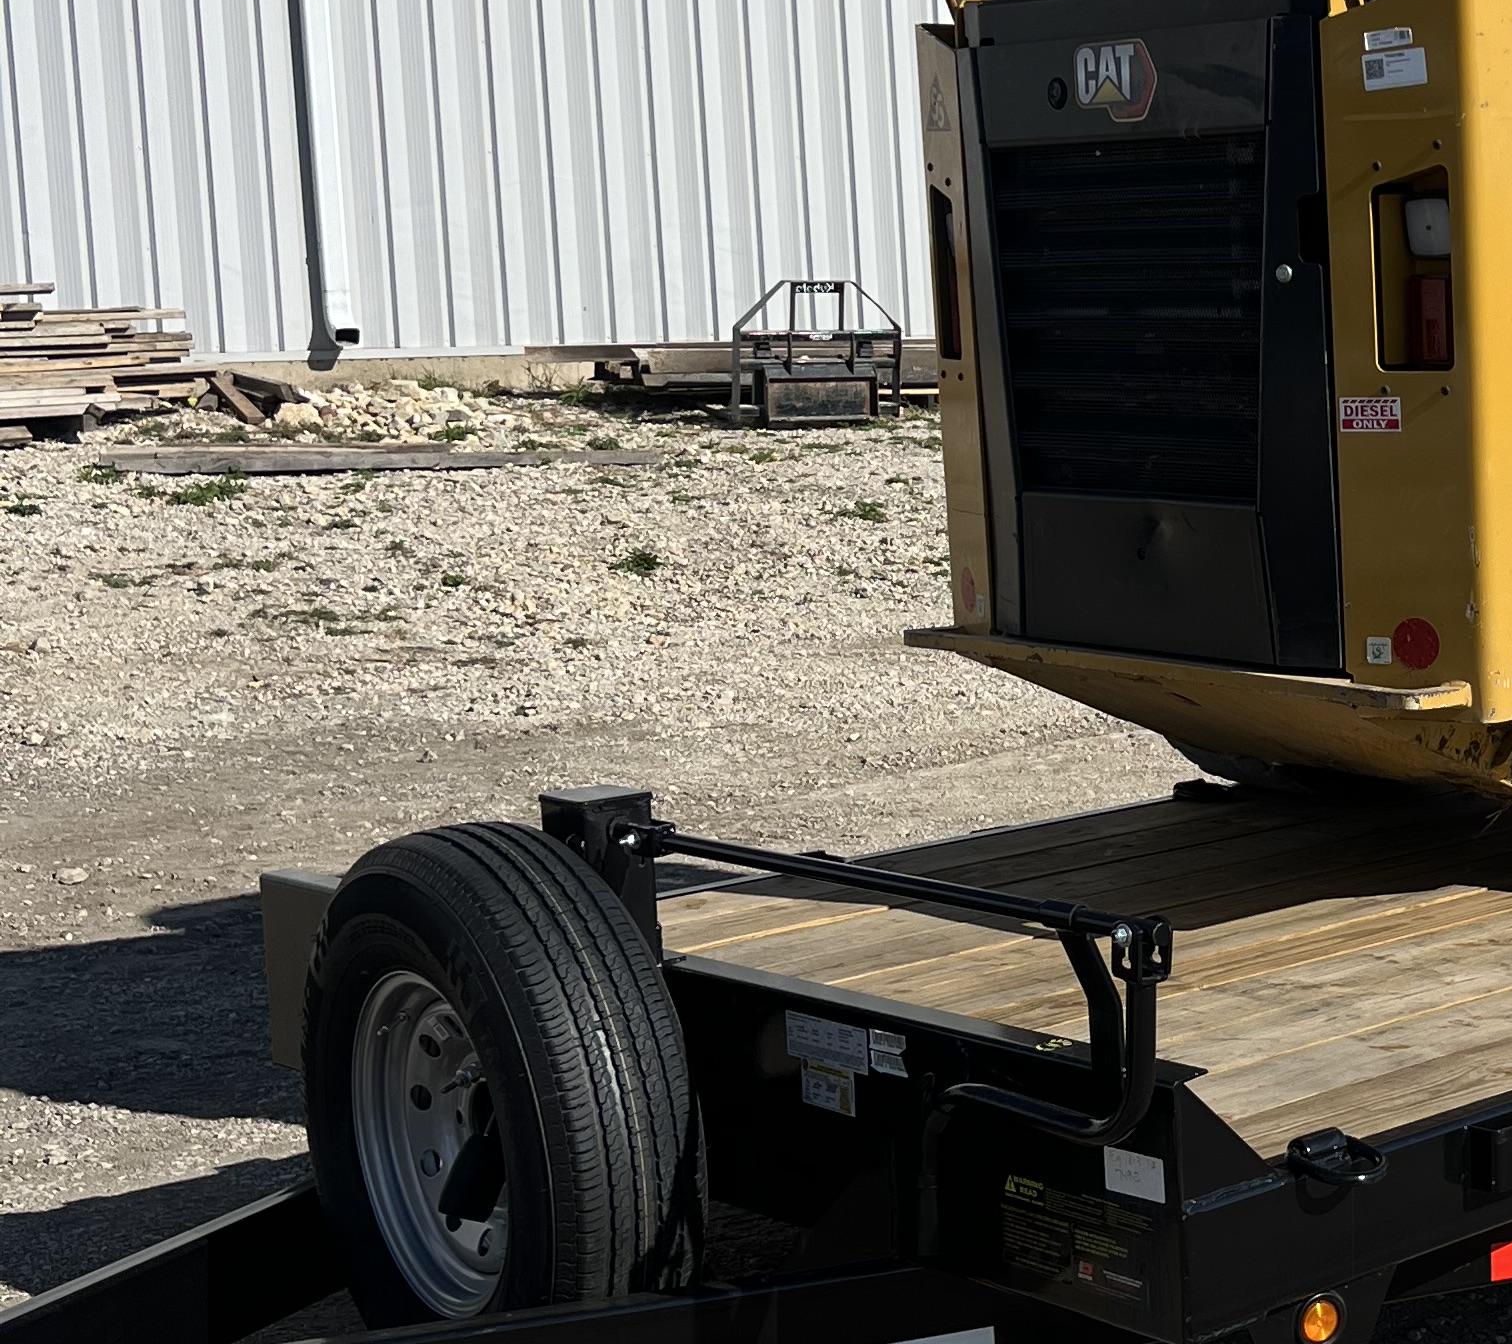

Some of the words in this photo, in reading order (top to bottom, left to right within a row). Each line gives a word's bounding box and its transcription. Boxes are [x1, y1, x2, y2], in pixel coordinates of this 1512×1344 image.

[1076, 43, 1135, 104] CAT
[1343, 404, 1398, 418] DIESEL
[1352, 419, 1388, 429] ONLY
